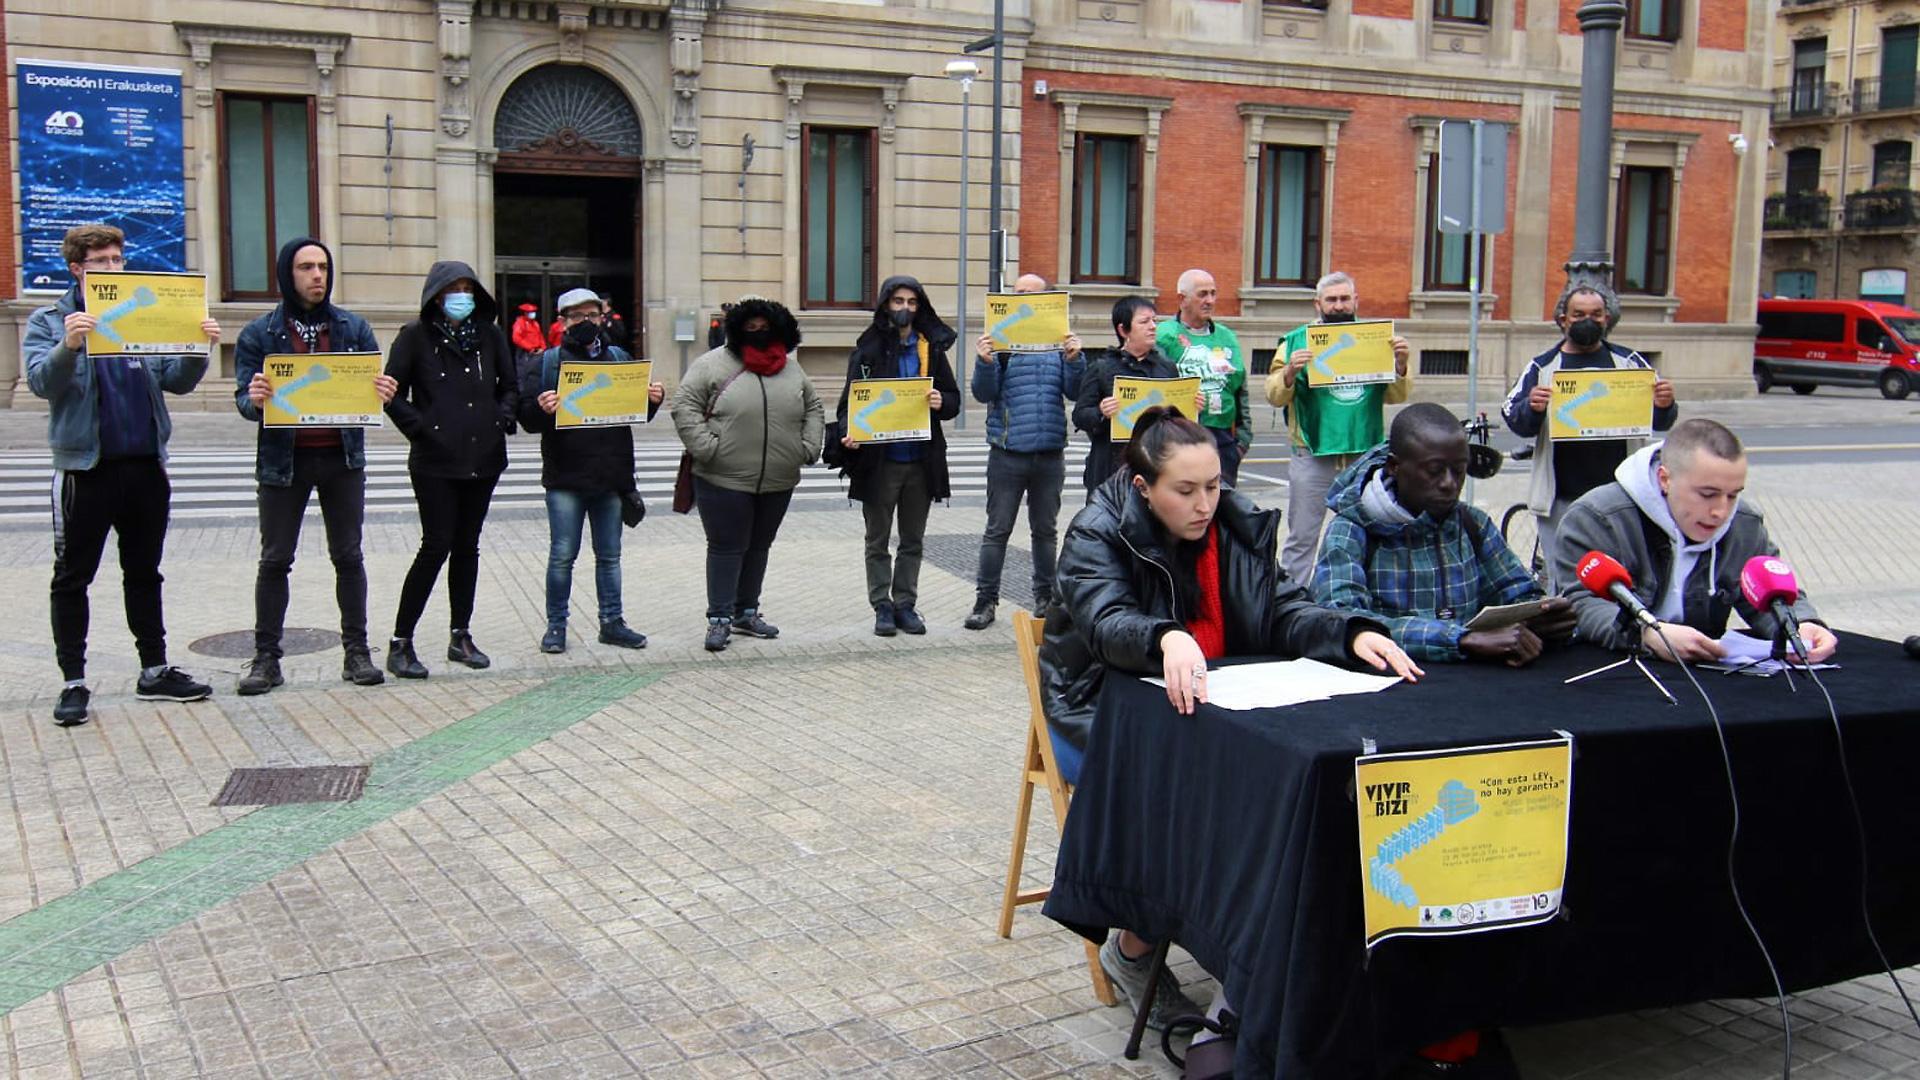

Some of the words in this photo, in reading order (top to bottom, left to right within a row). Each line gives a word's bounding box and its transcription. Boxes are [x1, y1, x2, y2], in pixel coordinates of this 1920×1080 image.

[26, 73, 96, 89] Exposición
[104, 79, 173, 94] Erakusketa
[1507, 775, 1528, 784] esta
[1365, 782, 1410, 802] VIVIR
[1496, 787, 1512, 796] hay
[1376, 799, 1408, 816] BIZI
